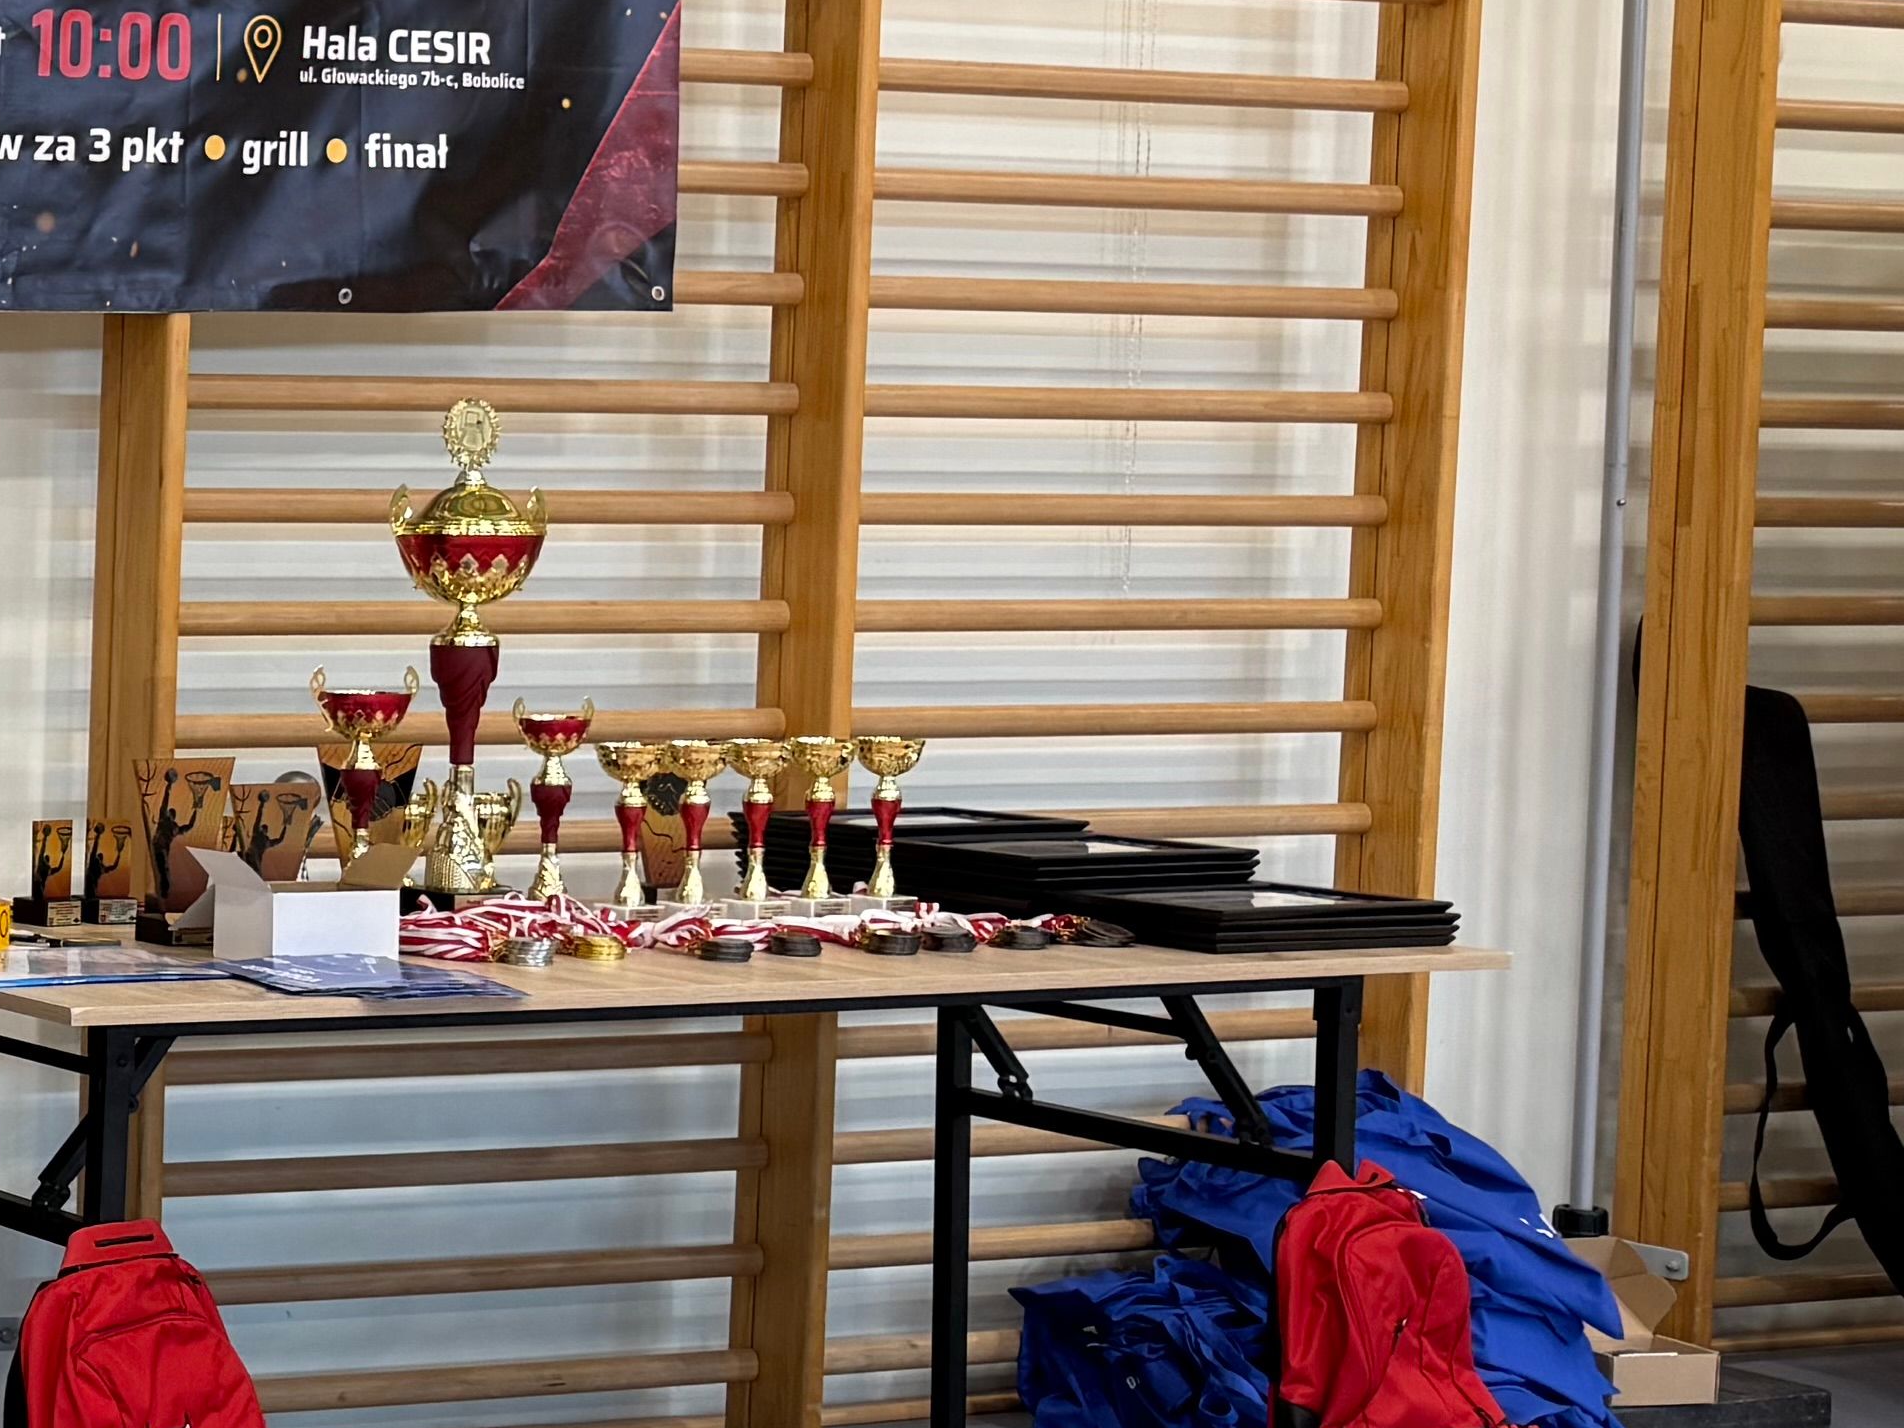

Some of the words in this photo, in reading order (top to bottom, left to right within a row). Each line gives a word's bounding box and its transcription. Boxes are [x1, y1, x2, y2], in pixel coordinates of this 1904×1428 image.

[32, 8, 192, 83] 10:00
[302, 25, 377, 62] Hala
[388, 28, 491, 65] CESIR
[299, 66, 318, 83] ul.
[462, 72, 525, 90] Bobolice
[33, 135, 76, 162] za
[88, 127, 111, 163] 3
[121, 126, 185, 172] pkt
[242, 130, 309, 175] grill
[364, 132, 449, 169] finał
